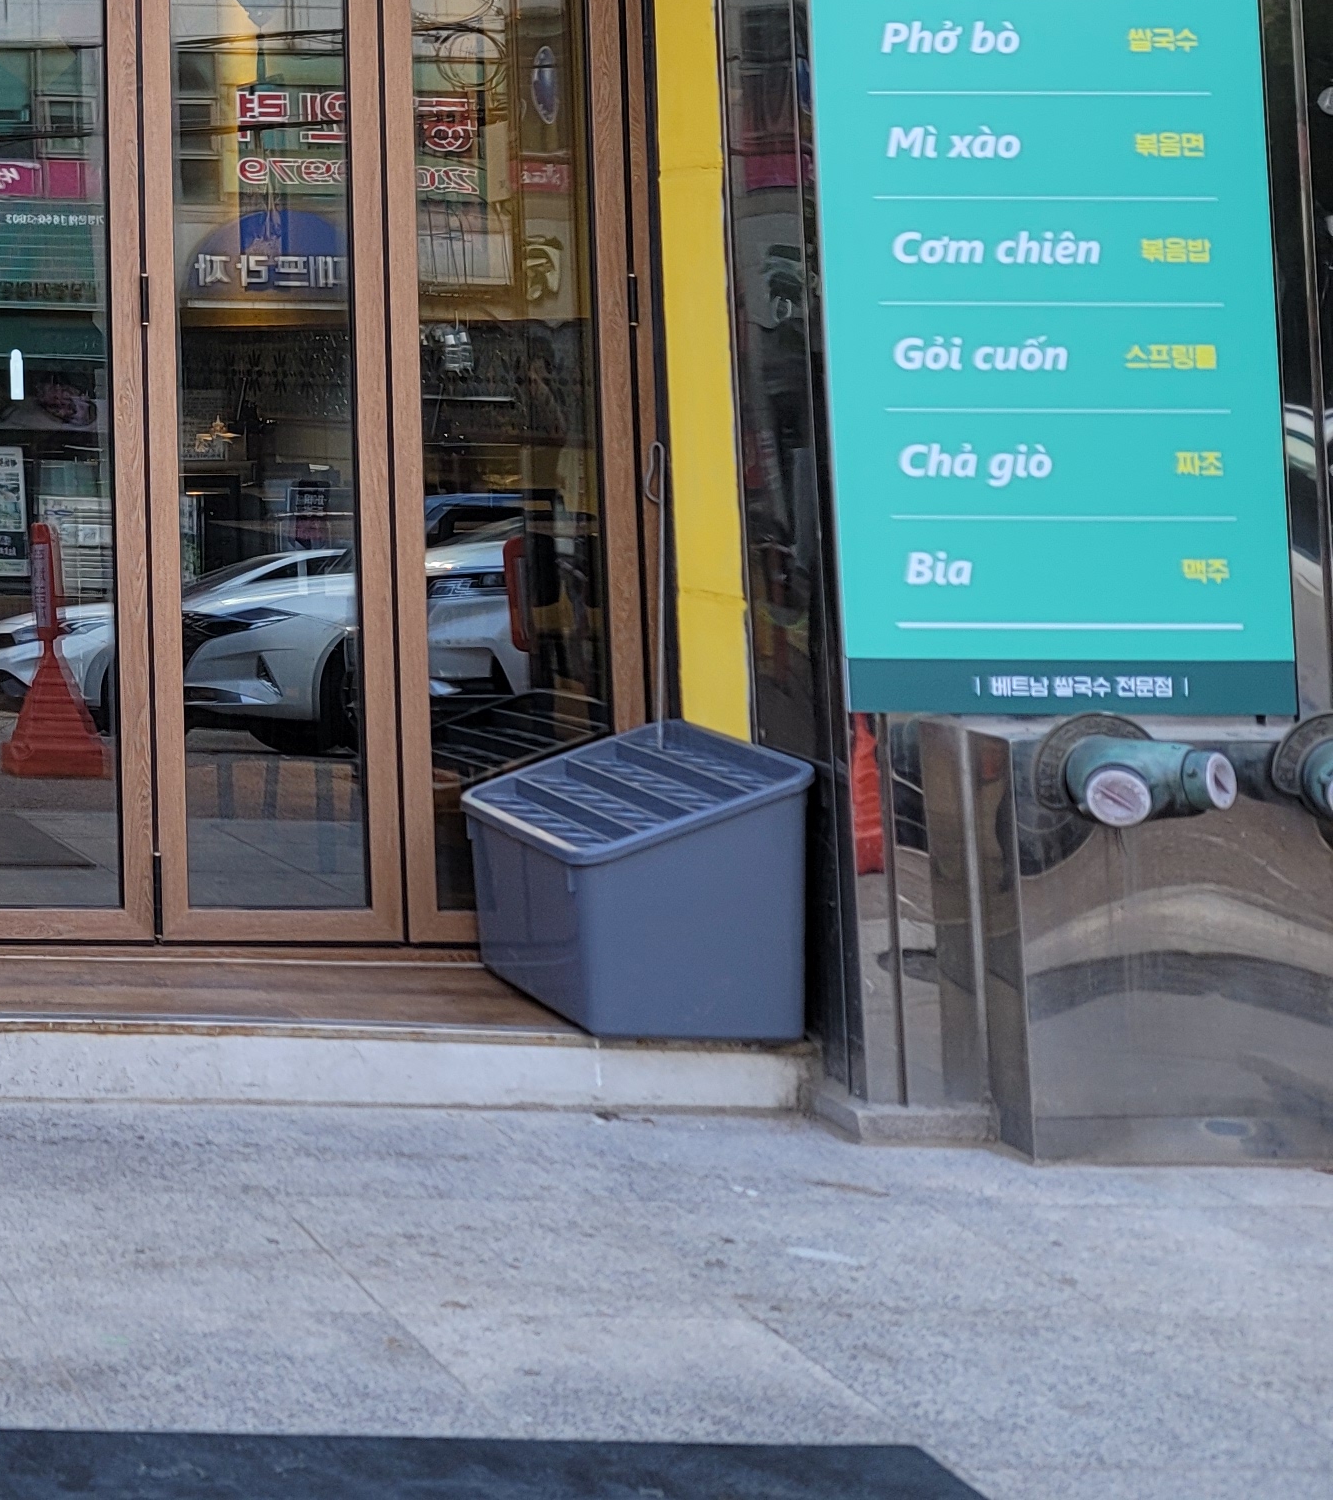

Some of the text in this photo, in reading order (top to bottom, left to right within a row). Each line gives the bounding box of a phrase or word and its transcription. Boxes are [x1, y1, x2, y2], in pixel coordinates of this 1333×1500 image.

[881, 20, 1020, 54] Phở bò
[1128, 28, 1197, 52] 쌀국수
[886, 125, 1021, 159] Mì xào
[1135, 132, 1204, 157] 볶음면
[893, 230, 1101, 265] Cơm chiên
[1141, 237, 1211, 263] 볶음밥
[894, 335, 1068, 371] Gỏi cuốn
[899, 443, 1053, 487] Chả giò
[1176, 451, 1222, 476] 짜조
[905, 551, 972, 585] Bia
[1182, 558, 1229, 583] 맥주
[990, 675, 1173, 698] 베트남 쌀국수 전문점
